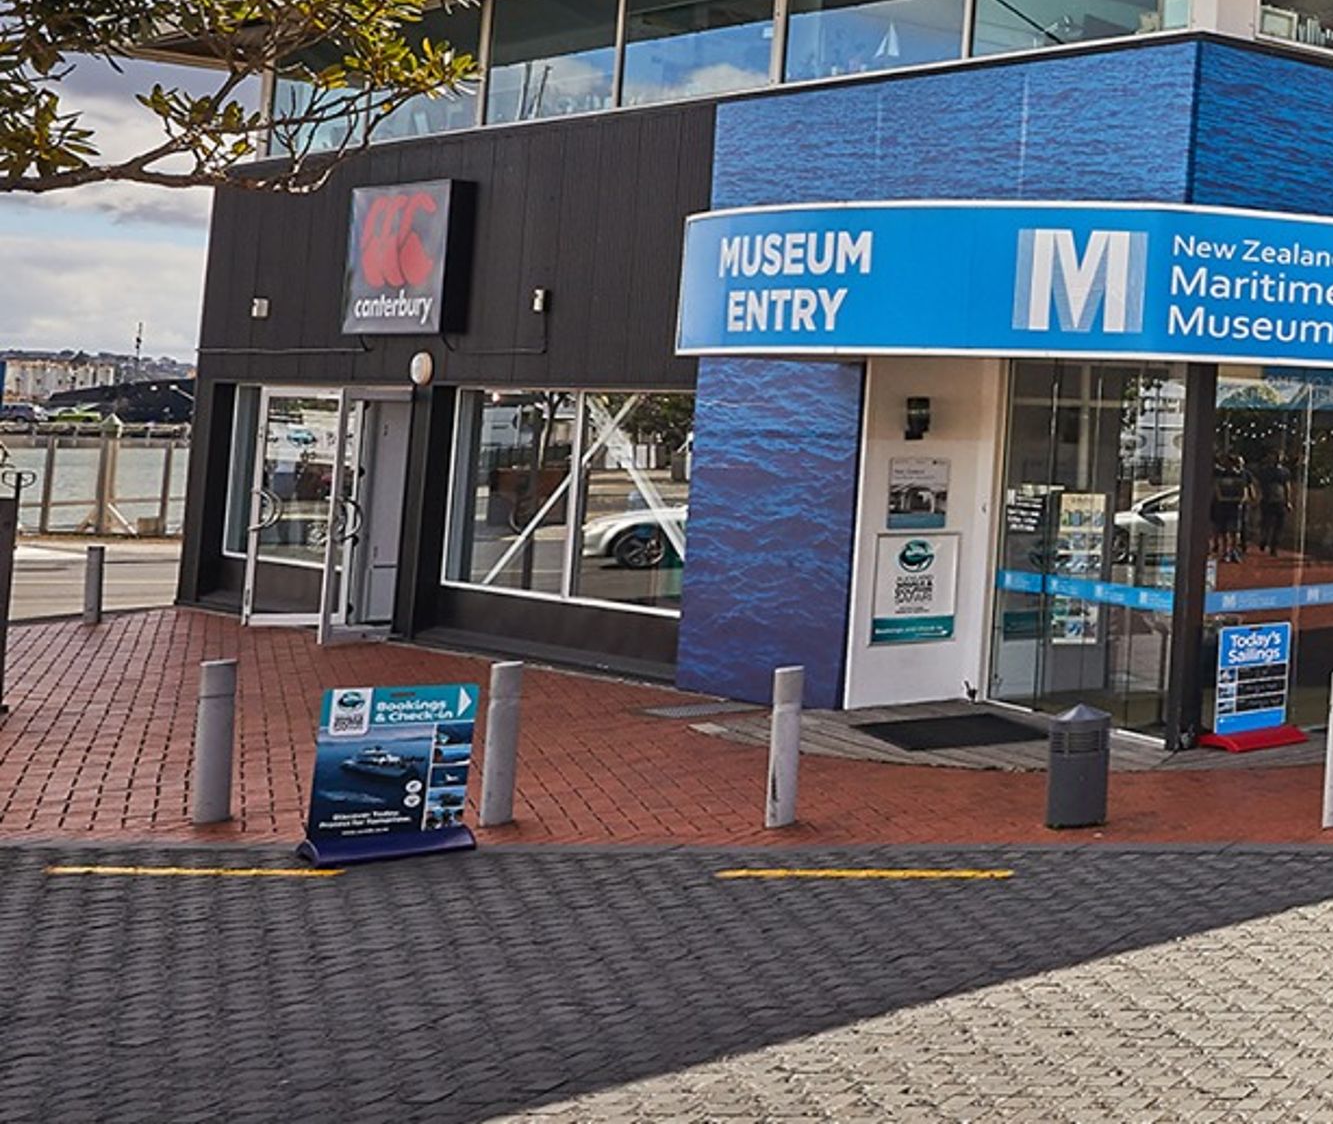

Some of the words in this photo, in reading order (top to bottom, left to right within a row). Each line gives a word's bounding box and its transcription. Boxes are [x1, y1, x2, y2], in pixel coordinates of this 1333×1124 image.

[719, 230, 873, 278] MUSEUM
[1172, 234, 1237, 261] New
[1012, 228, 1149, 333] M
[353, 288, 433, 325] canterbury
[726, 287, 848, 333] ENTRY
[1229, 631, 1282, 649] Today's
[1228, 647, 1280, 664] Sailings
[374, 712, 386, 723] &
[388, 710, 453, 723] Check-in
[376, 699, 447, 712] Bookings
